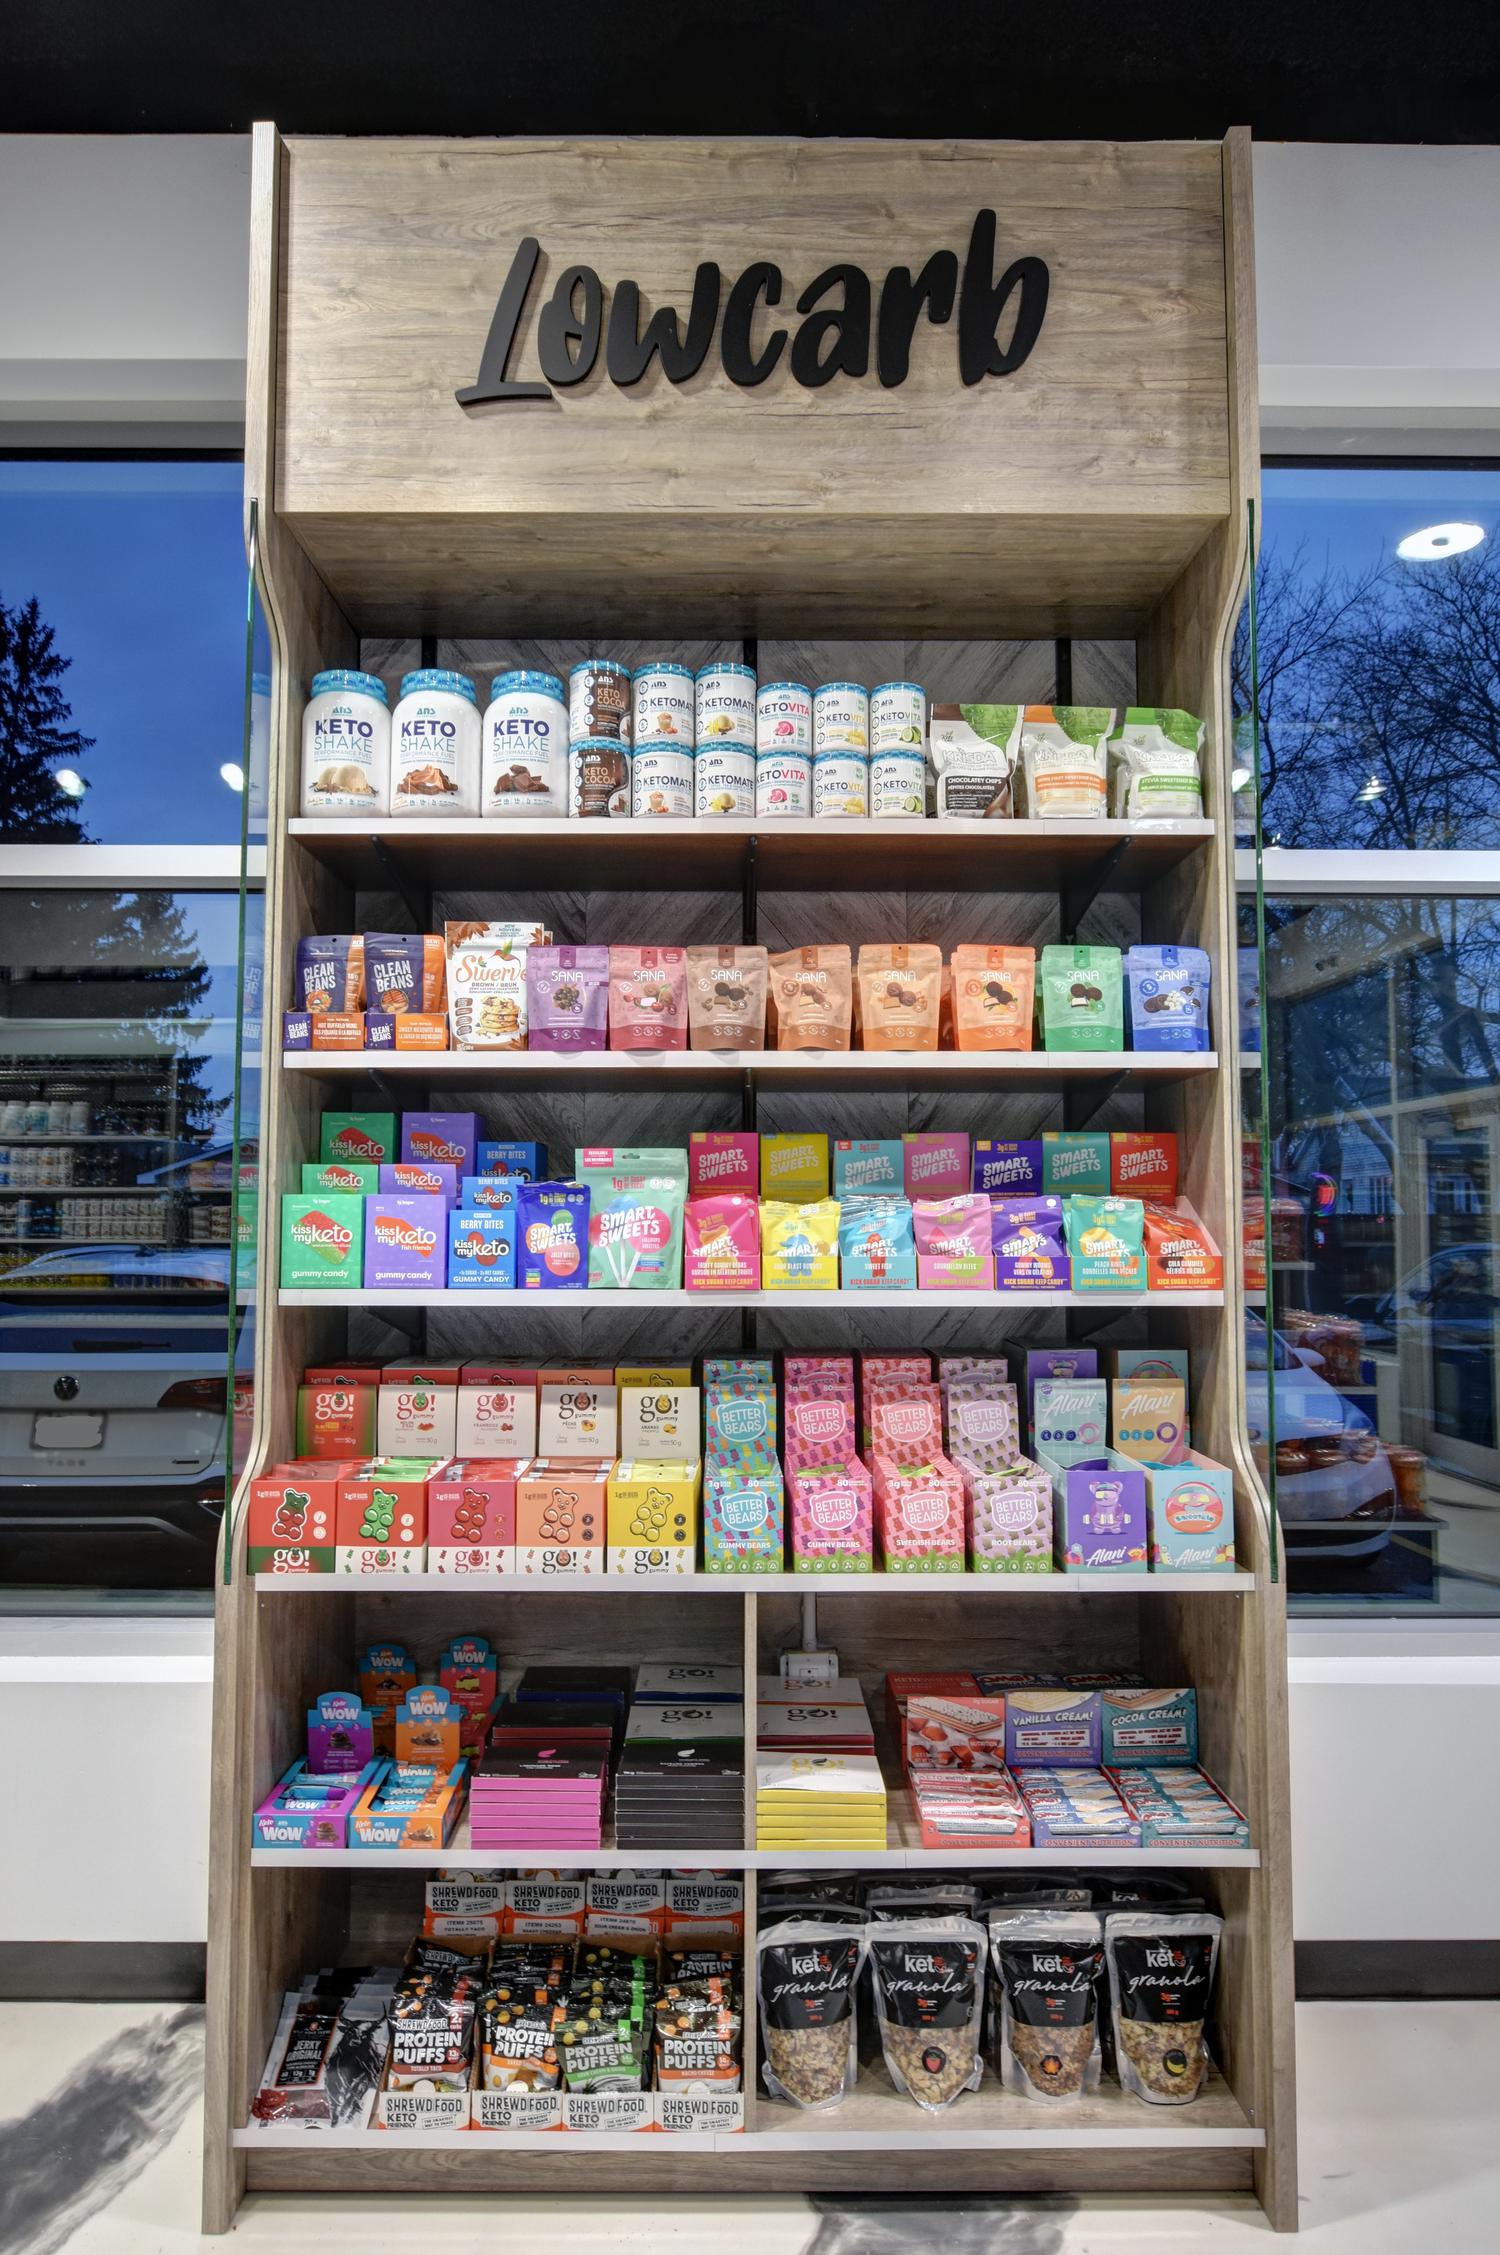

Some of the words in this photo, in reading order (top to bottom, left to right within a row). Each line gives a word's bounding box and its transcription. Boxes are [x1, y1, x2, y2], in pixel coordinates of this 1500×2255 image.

[455, 209, 1050, 406] Lowcarb
[598, 697, 625, 708] COCOA
[705, 698, 755, 712] KETOMATE
[759, 702, 810, 716] KETOVITA
[881, 712, 921, 721] KETOVITA
[316, 719, 373, 737] KETO
[401, 720, 456, 737] KETO
[494, 719, 550, 737] KETO
[314, 736, 372, 753] SHAKE
[400, 737, 455, 752] SHAKE
[493, 737, 550, 752] SHAKE
[585, 776, 616, 785] COCOA
[644, 776, 692, 790] KETOMATE
[708, 775, 753, 789] KETOMATE
[303, 962, 334, 981] CLEAN
[374, 961, 411, 979] CLEAN
[456, 955, 526, 982] Swerve
[551, 971, 584, 982] SANA
[633, 970, 666, 981] SANA
[711, 970, 742, 981] SANA
[884, 970, 917, 981] SANA
[305, 976, 336, 994] BEANS
[376, 974, 414, 993] BEANS
[795, 972, 827, 983] SANA
[288, 1024, 307, 1032] CLEAN
[289, 1030, 308, 1038] BEANS
[507, 1151, 526, 1159] BITES
[699, 1149, 744, 1167] SMART
[770, 1145, 815, 1163] SMART
[1052, 1148, 1096, 1166] SMART
[1120, 1148, 1164, 1167] SMART
[699, 1159, 748, 1181] SWEETS
[770, 1157, 819, 1177] SWEETS
[845, 1156, 889, 1176] SMART
[983, 1157, 1029, 1176] SMART
[1052, 1159, 1100, 1181] SWEETS
[1120, 1159, 1168, 1181] SWEETS
[319, 1179, 333, 1188] my
[333, 1172, 364, 1187] keto
[845, 1169, 894, 1190] SWEETS
[983, 1168, 1033, 1189] SWEETS
[461, 1220, 483, 1229] BERRY
[485, 1220, 504, 1229] BITES
[601, 1206, 656, 1230] SMART
[291, 1225, 311, 1235] kiss
[294, 1234, 312, 1245] my
[312, 1224, 352, 1243] keto
[375, 1226, 395, 1235] kiss
[378, 1235, 395, 1246] my
[395, 1225, 436, 1245] keto
[530, 1223, 573, 1239] SMART
[599, 1220, 660, 1247] SWEETS
[455, 1240, 473, 1248] kiss
[458, 1248, 473, 1257] my
[473, 1241, 509, 1256] keto
[530, 1233, 576, 1253] SWEETS
[292, 1270, 320, 1279] gummy
[323, 1269, 348, 1279] candy
[376, 1272, 403, 1281] gummy
[405, 1271, 432, 1280] candy
[1043, 1393, 1096, 1418] Alani
[1120, 1392, 1175, 1420] Alani
[413, 1413, 435, 1421] gummy
[722, 1407, 761, 1423] BETTER
[801, 1407, 840, 1423] BETTER
[888, 1407, 926, 1423] BETTER
[964, 1407, 1002, 1423] BETTER
[725, 1419, 761, 1435] BEARS
[803, 1419, 840, 1435] BEARS
[891, 1420, 927, 1435] BEARS
[968, 1420, 1003, 1435] BEARS
[727, 1498, 763, 1512] BETTER
[816, 1498, 851, 1512] BETTER
[907, 1498, 943, 1512] BETTER
[729, 1510, 762, 1525] BEARS
[818, 1510, 852, 1525] BEARS
[910, 1510, 944, 1525] BEARS
[999, 1510, 1032, 1525] BEARS
[1086, 1546, 1126, 1568] Alani
[1175, 1546, 1215, 1568] Alani
[1012, 1714, 1052, 1727] VANILLA
[1056, 1712, 1094, 1722] CREAM!
[1112, 1713, 1145, 1727] COCOA
[1148, 1709, 1186, 1720] CREAM!
[433, 1887, 472, 1898] SHREWD
[593, 1897, 618, 1905] KETO
[772, 1969, 850, 2003] granola
[887, 1972, 968, 1995] granola
[1013, 1972, 1091, 1996] granola
[1128, 1965, 1206, 1993] granola
[294, 2041, 321, 2050] JERKY
[494, 2042, 544, 2058] PUFFS
[287, 2050, 321, 2062] ORIGINAL
[393, 2048, 445, 2064] PUFFS
[566, 2054, 619, 2072] PUFFS
[664, 2055, 715, 2069] PUFFS
[387, 2099, 432, 2113] SHREWD
[482, 2097, 527, 2112] SHREWD
[570, 2100, 614, 2113] SHREWD
[663, 2100, 708, 2114] SHREWD
[387, 2113, 417, 2122] KETO
[482, 2112, 511, 2120] KETO
[570, 2114, 599, 2123] KETO
[663, 2115, 693, 2123] KETO
